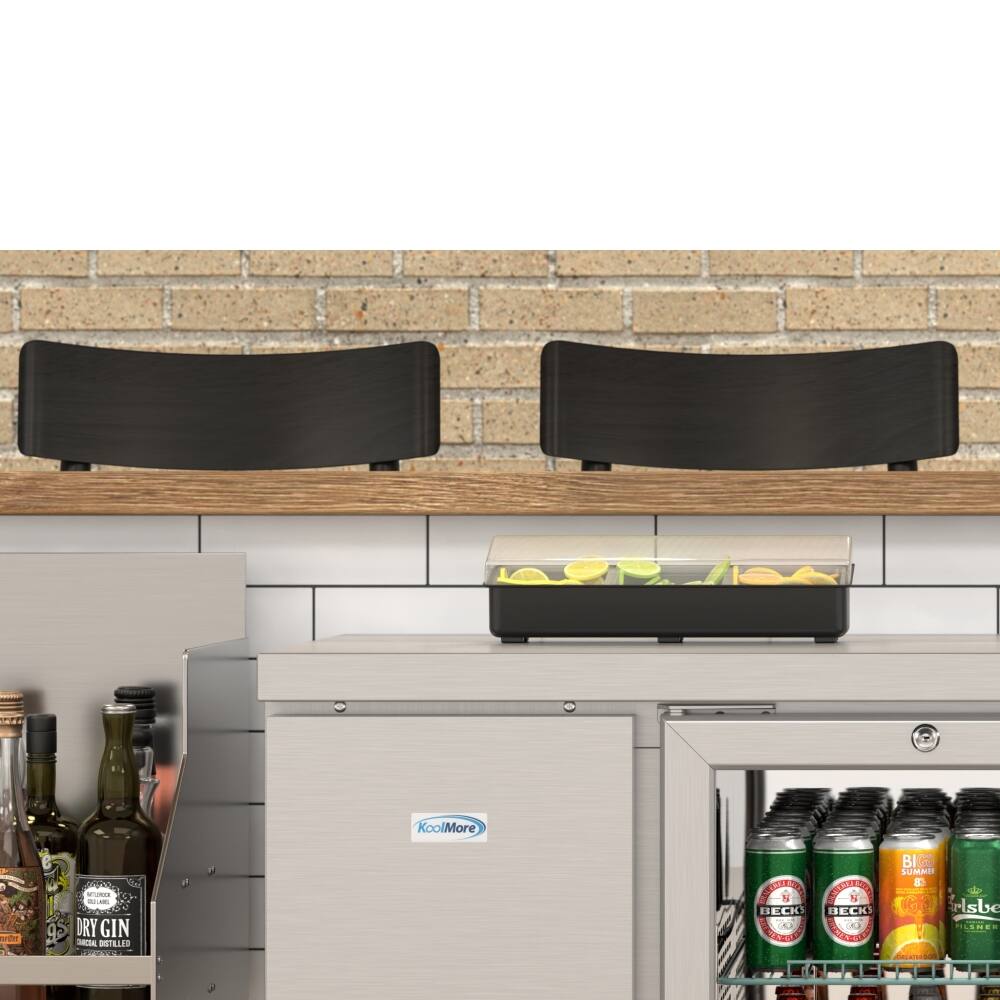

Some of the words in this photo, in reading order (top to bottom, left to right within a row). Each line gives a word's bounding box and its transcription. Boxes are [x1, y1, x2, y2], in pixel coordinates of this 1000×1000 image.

[417, 822, 476, 834] KoolMore
[902, 854, 935, 869] BIG
[760, 905, 806, 916] BECK'S
[827, 905, 873, 916] BECK'S
[77, 917, 98, 938] DRY
[100, 918, 130, 938] GIN
[99, 939, 131, 948] DISTILLED
